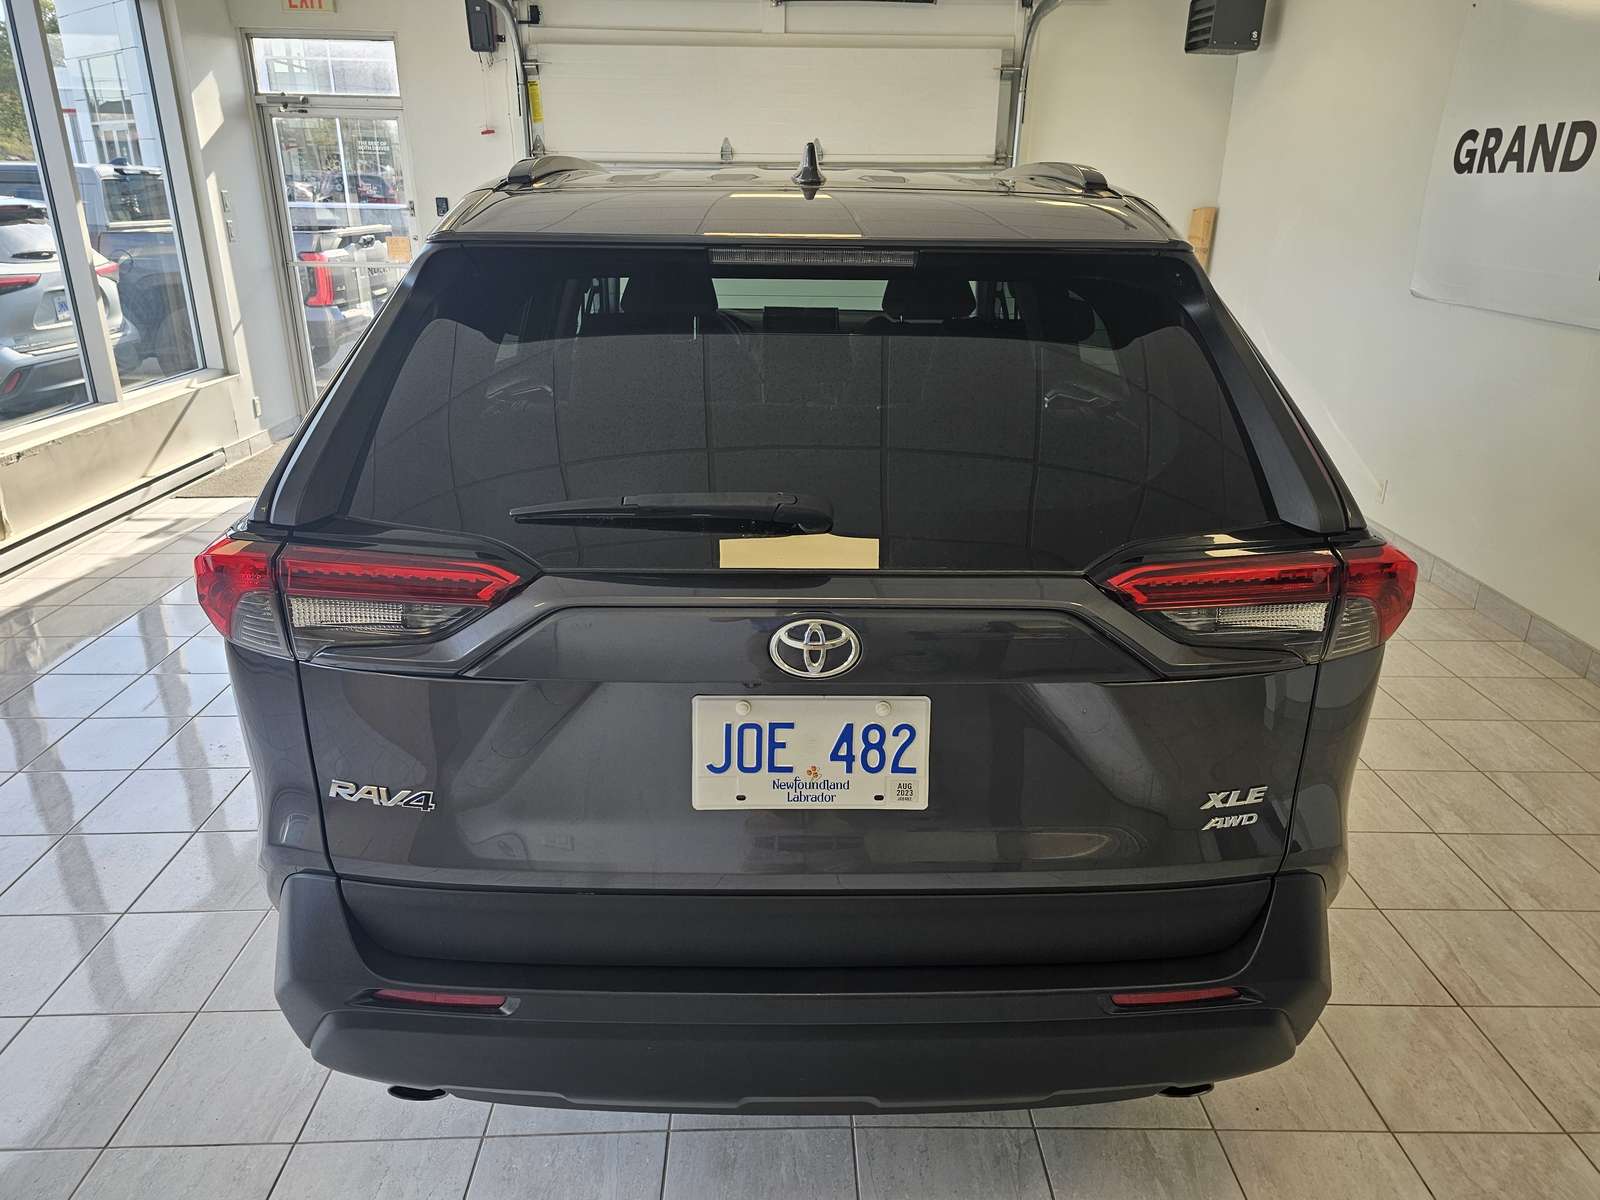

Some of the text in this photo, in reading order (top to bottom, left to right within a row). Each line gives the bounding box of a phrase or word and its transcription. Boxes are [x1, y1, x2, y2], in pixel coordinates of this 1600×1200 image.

[1453, 120, 1597, 174] GRAND
[706, 722, 917, 774] JOE 482
[772, 776, 850, 793] Newfoundland
[896, 789, 914, 797] 2023
[897, 782, 913, 790] AUG
[329, 779, 436, 812] RAV4
[787, 790, 837, 803] Labrador
[1200, 786, 1268, 810] XLE
[1201, 813, 1259, 831] AWD
